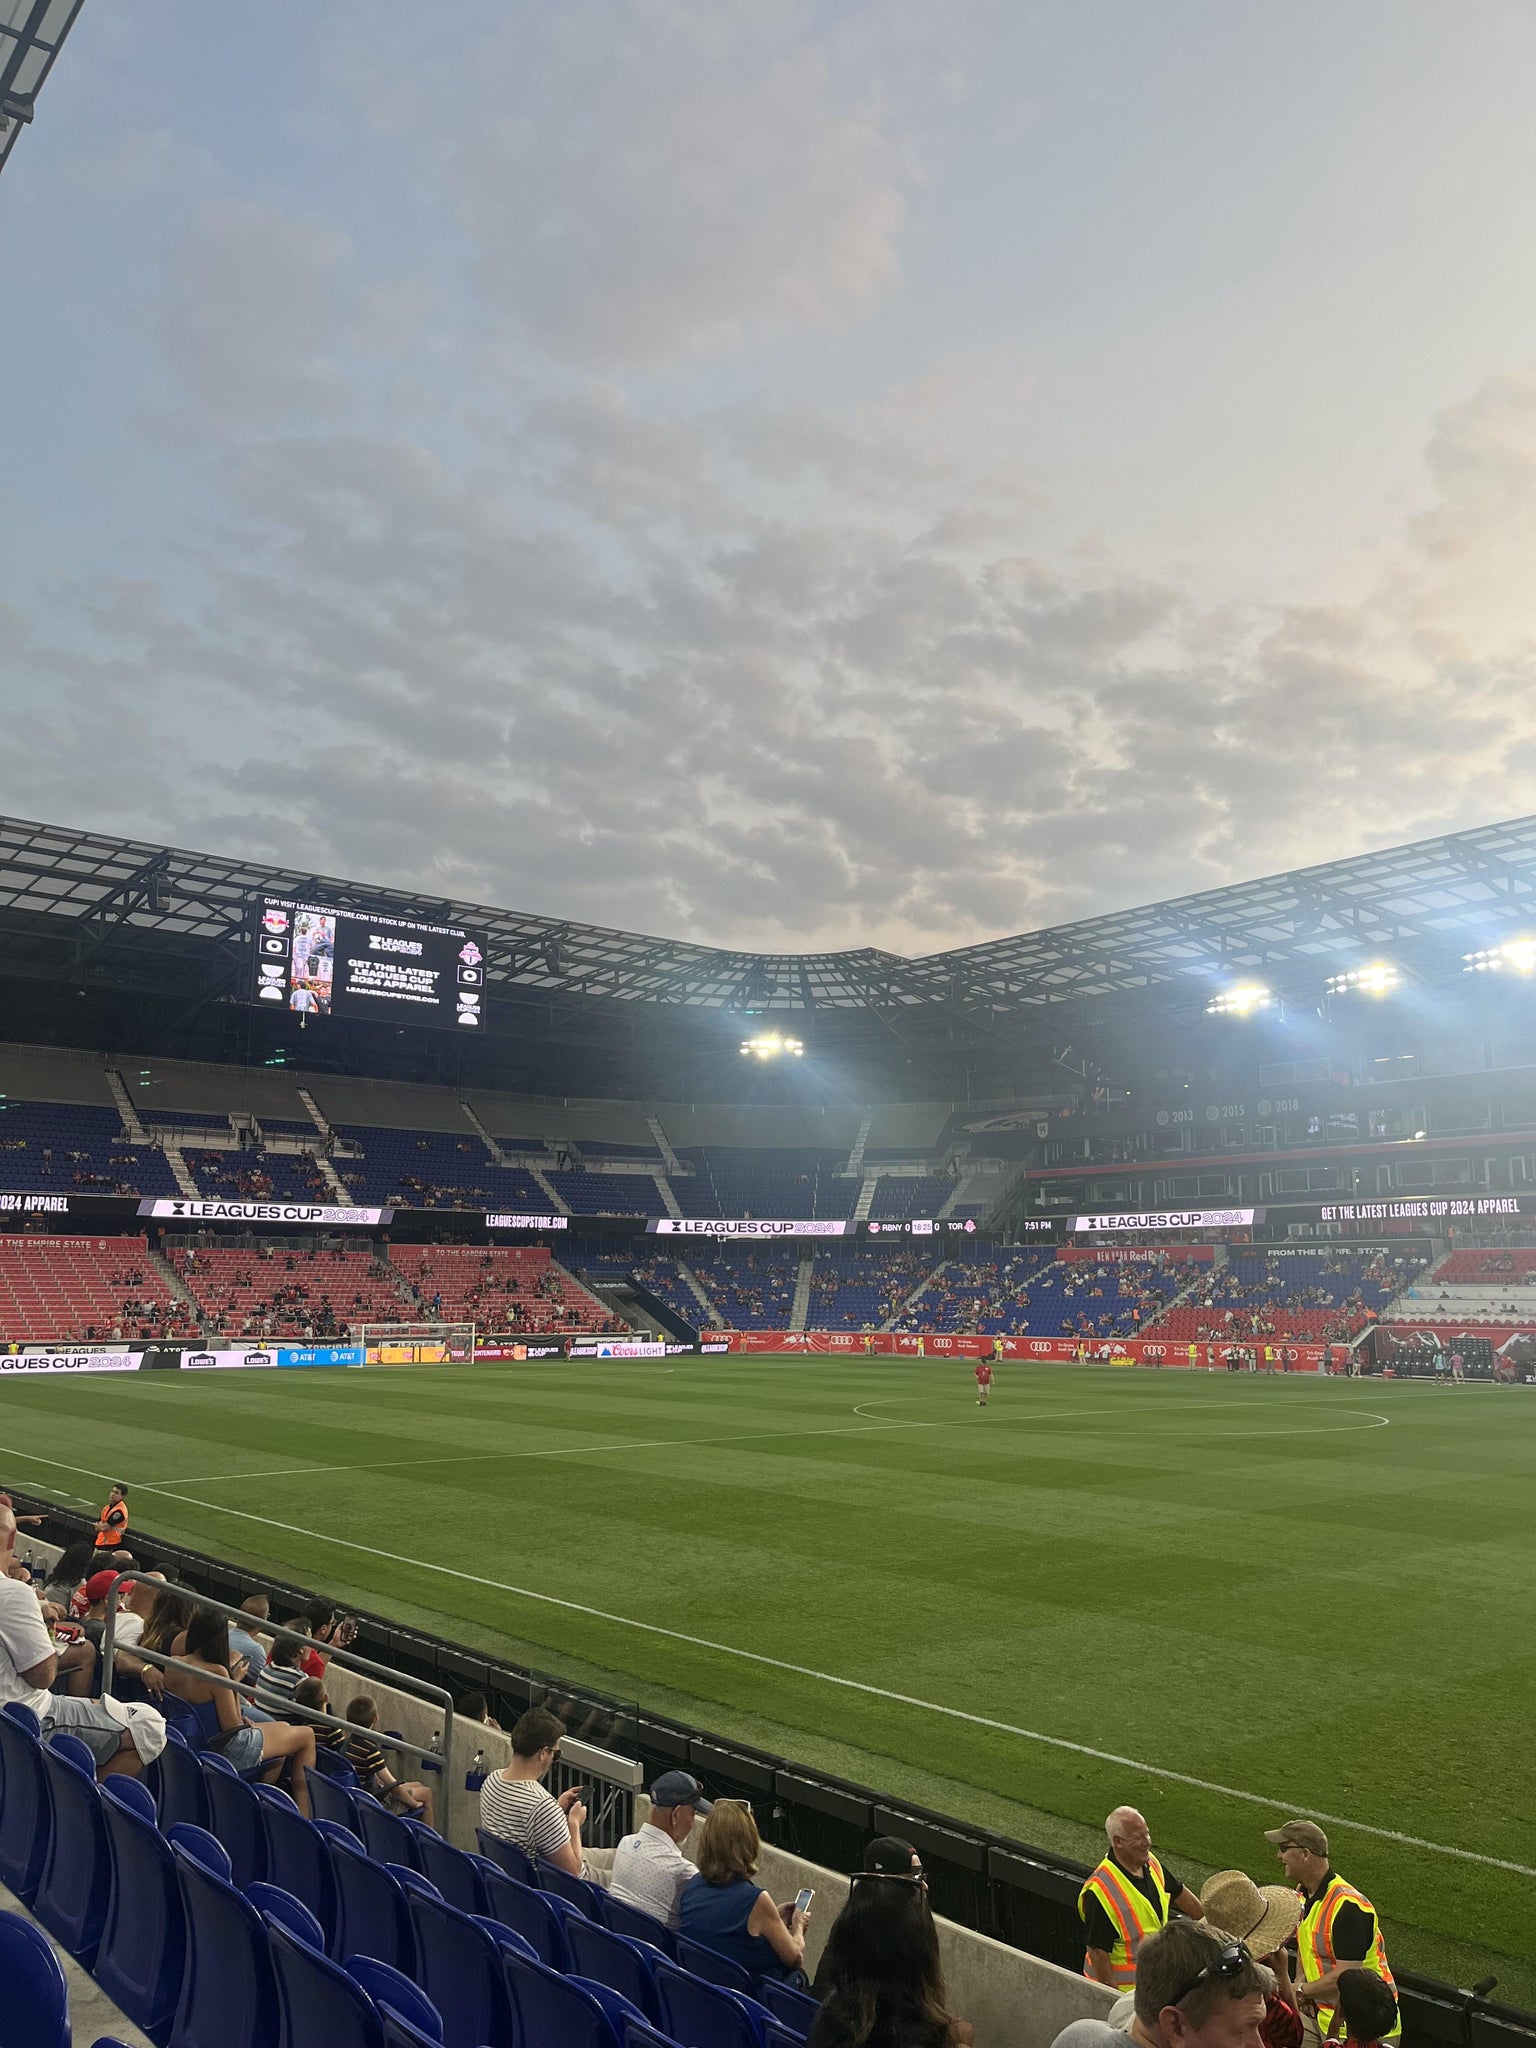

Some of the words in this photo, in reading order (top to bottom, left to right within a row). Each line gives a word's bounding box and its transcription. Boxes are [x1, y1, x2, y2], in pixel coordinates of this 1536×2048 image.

[281, 900, 296, 908] VISIT
[297, 902, 369, 920] LEAGUESCUPSTORE.COM
[379, 917, 397, 926] STOCK
[417, 923, 428, 931] THE
[429, 925, 450, 935] LATEST
[381, 937, 422, 950] LEAGUES
[381, 943, 400, 952] CUP
[348, 959, 371, 969] GET
[373, 962, 396, 972] THE
[398, 965, 440, 979] LATEST
[354, 967, 407, 982] LEAGUES
[409, 974, 433, 985] CUP
[350, 975, 382, 986] 2024
[383, 980, 435, 993] APPAREL
[345, 986, 439, 1004] LEAGUESCUPSTORE.COM
[1222, 1104, 1245, 1117] 2015
[1275, 1099, 1299, 1112] 2018
[1172, 1110, 1193, 1122] 2013
[0, 1195, 22, 1210] 024
[24, 1196, 69, 1212] APPAREL
[1321, 1206, 1336, 1220] GET
[1339, 1206, 1355, 1219] THE
[1357, 1204, 1387, 1219] LATEST
[1389, 1202, 1427, 1218] LEAGUES
[1430, 1201, 1448, 1216] CUP
[1450, 1200, 1475, 1215] 2024
[1477, 1199, 1519, 1214] APPAREL
[189, 1203, 280, 1219] LEAGUES
[283, 1206, 322, 1220] CUP
[323, 1208, 369, 1222] 2024
[1100, 1215, 1166, 1228] LEAGUES
[1169, 1213, 1201, 1226] CUP
[1202, 1211, 1243, 1225] 2024
[485, 1214, 568, 1229] LEAGUESCUPSTORE.COM
[685, 1222, 757, 1233] LEAGUES
[760, 1222, 793, 1233] CUP
[794, 1222, 835, 1234] 2024
[882, 1223, 902, 1231] RBNY
[904, 1223, 911, 1231] 0
[934, 1222, 940, 1231] 0
[948, 1222, 963, 1230] TOR
[1025, 1221, 1038, 1230] 7:51
[1040, 1221, 1051, 1229] PM
[27, 1240, 61, 1248] EMPIRE
[63, 1241, 91, 1249] STATE
[612, 1343, 638, 1357] Coors
[639, 1347, 662, 1356] LIGHT
[0, 1358, 49, 1370] GUES
[52, 1357, 88, 1368] CUP
[89, 1357, 131, 1368] 2024
